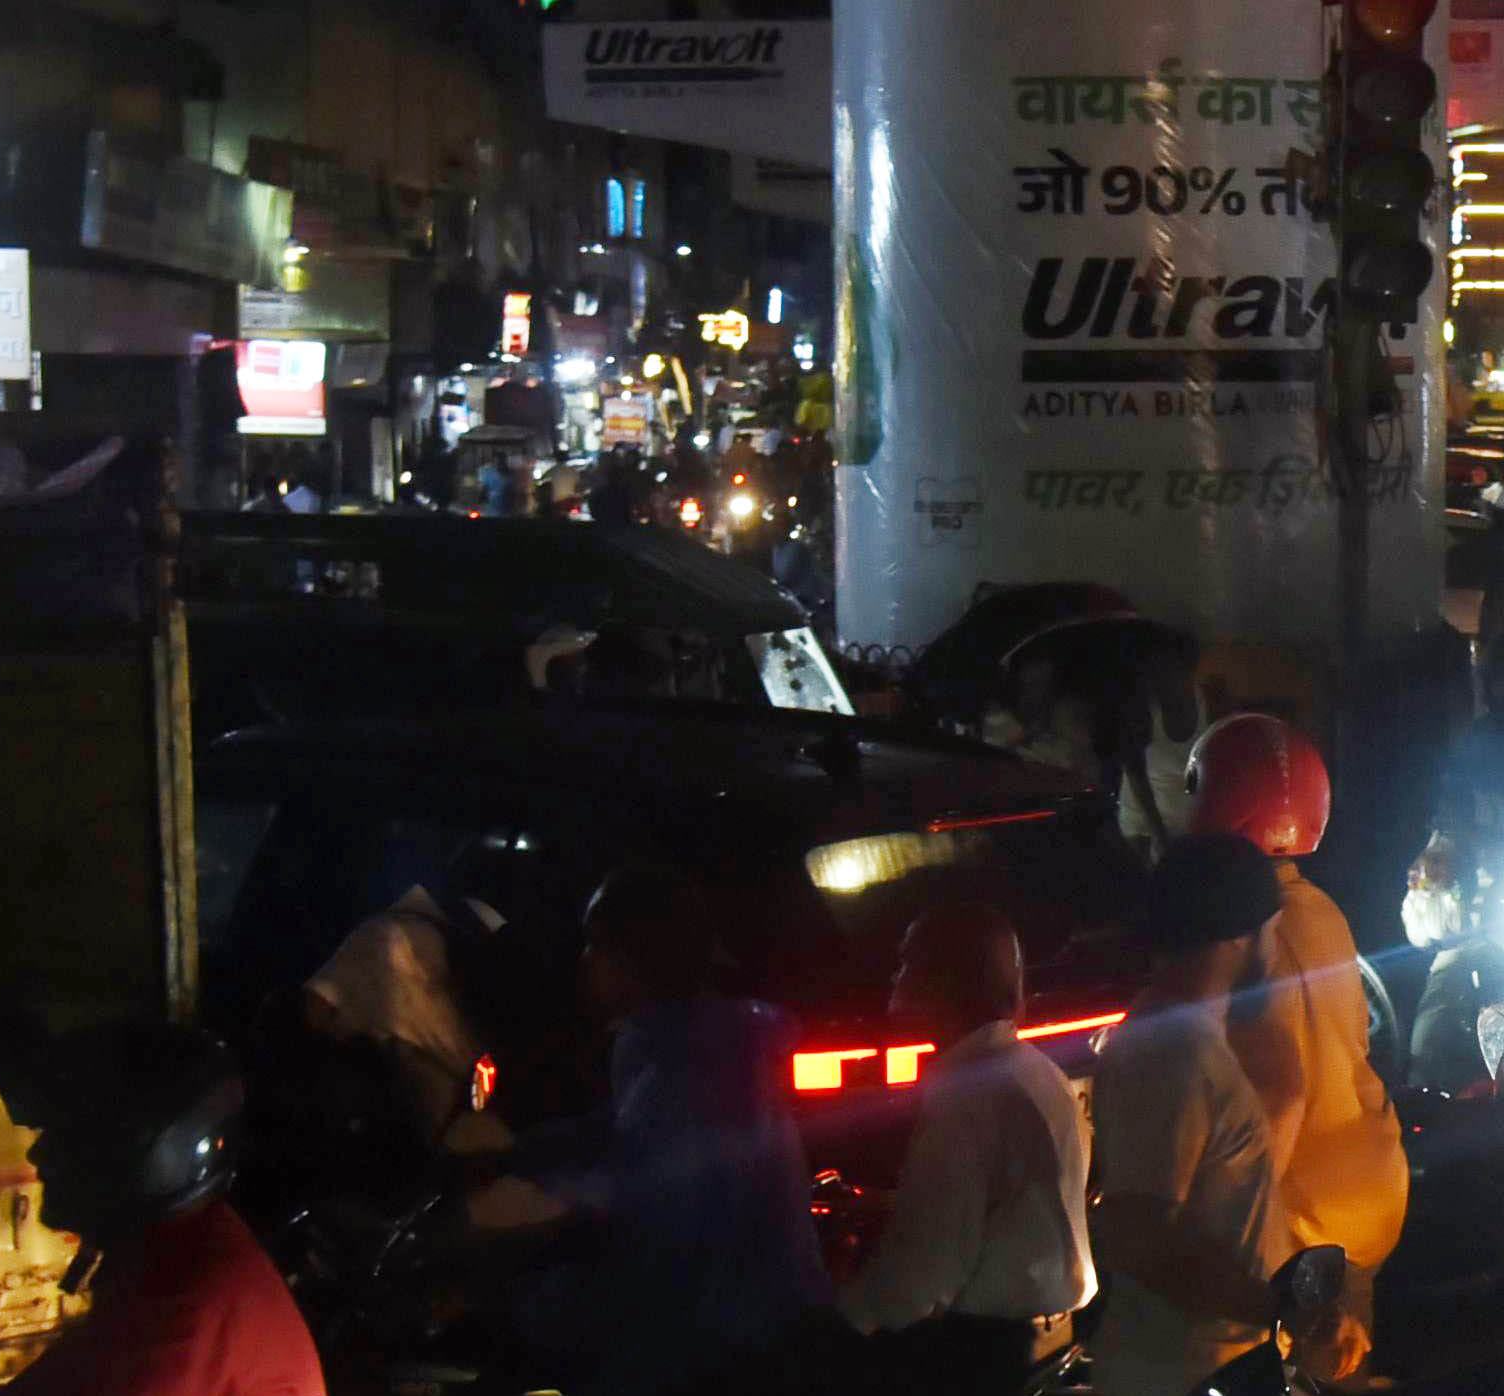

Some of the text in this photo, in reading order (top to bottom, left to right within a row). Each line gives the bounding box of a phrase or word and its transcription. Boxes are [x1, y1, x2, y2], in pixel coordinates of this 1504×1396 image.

[585, 27, 783, 64] Ultravolt
[1193, 73, 1278, 125] का
[1013, 148, 1091, 216] जो
[1101, 165, 1247, 217] 90%
[1023, 390, 1140, 418] ADITYA
